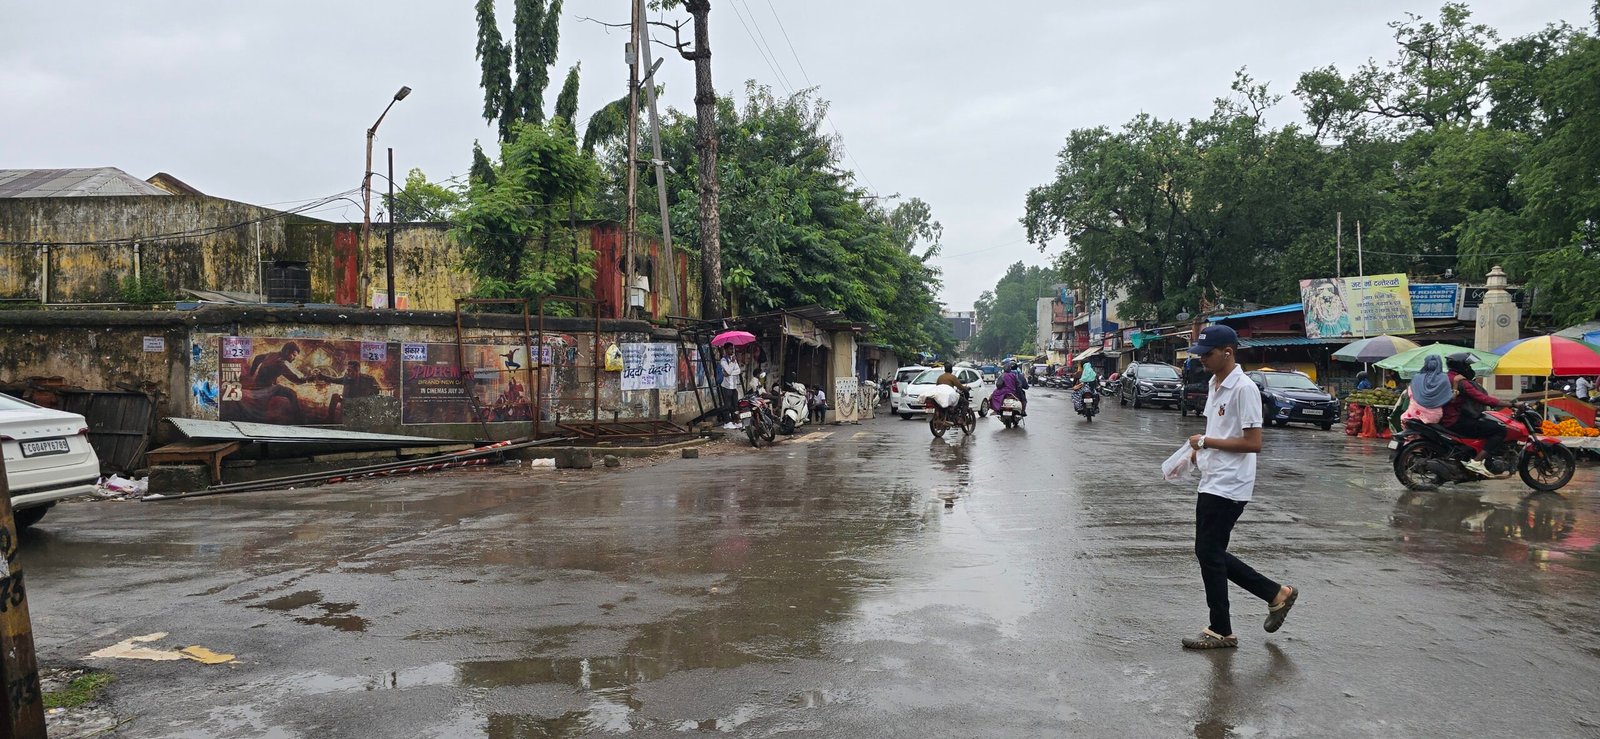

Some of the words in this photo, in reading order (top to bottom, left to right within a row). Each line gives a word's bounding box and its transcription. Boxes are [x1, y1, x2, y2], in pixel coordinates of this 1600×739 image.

[232, 348, 244, 357] 23
[221, 372, 241, 382] JULY
[222, 382, 242, 401] 23
[28, 440, 67, 453] CG04PY6789
